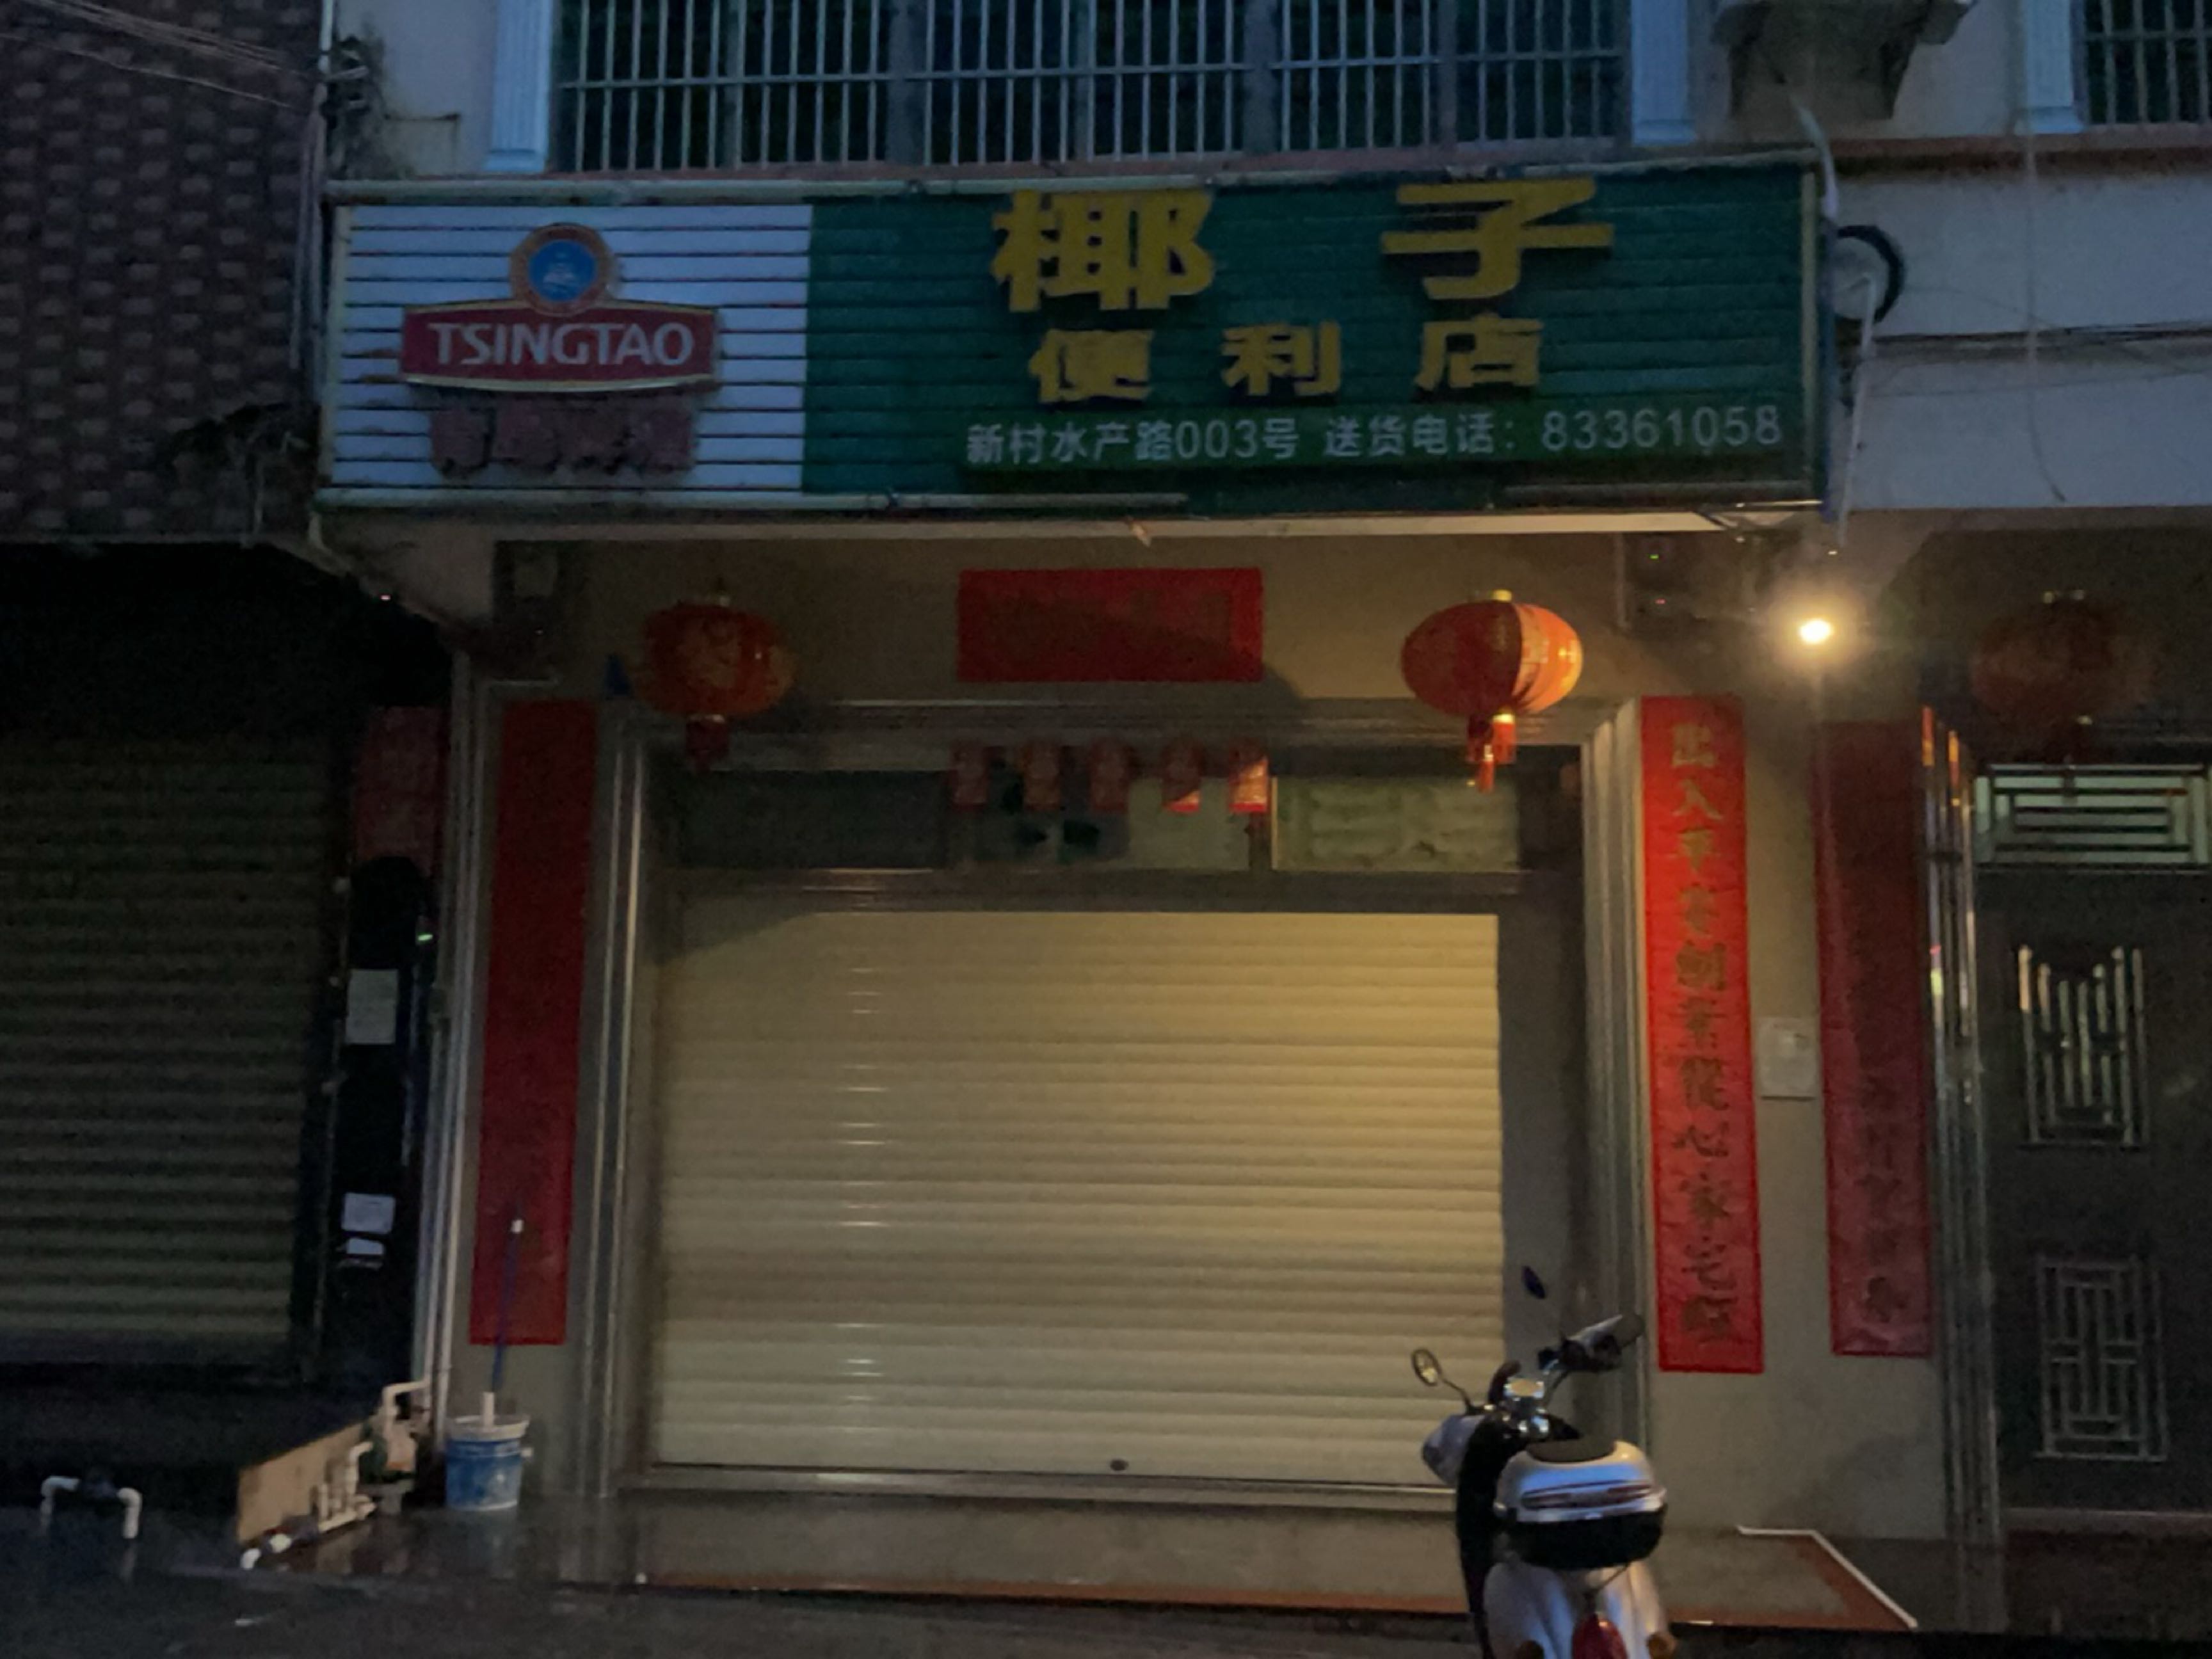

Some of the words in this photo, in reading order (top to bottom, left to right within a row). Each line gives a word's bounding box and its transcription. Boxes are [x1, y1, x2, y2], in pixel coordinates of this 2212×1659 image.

[991, 177, 1614, 312] 椰子
[428, 323, 694, 366] TSINGTAO
[1028, 312, 1544, 404] 便利店
[966, 418, 1298, 465] 新村水产路003号
